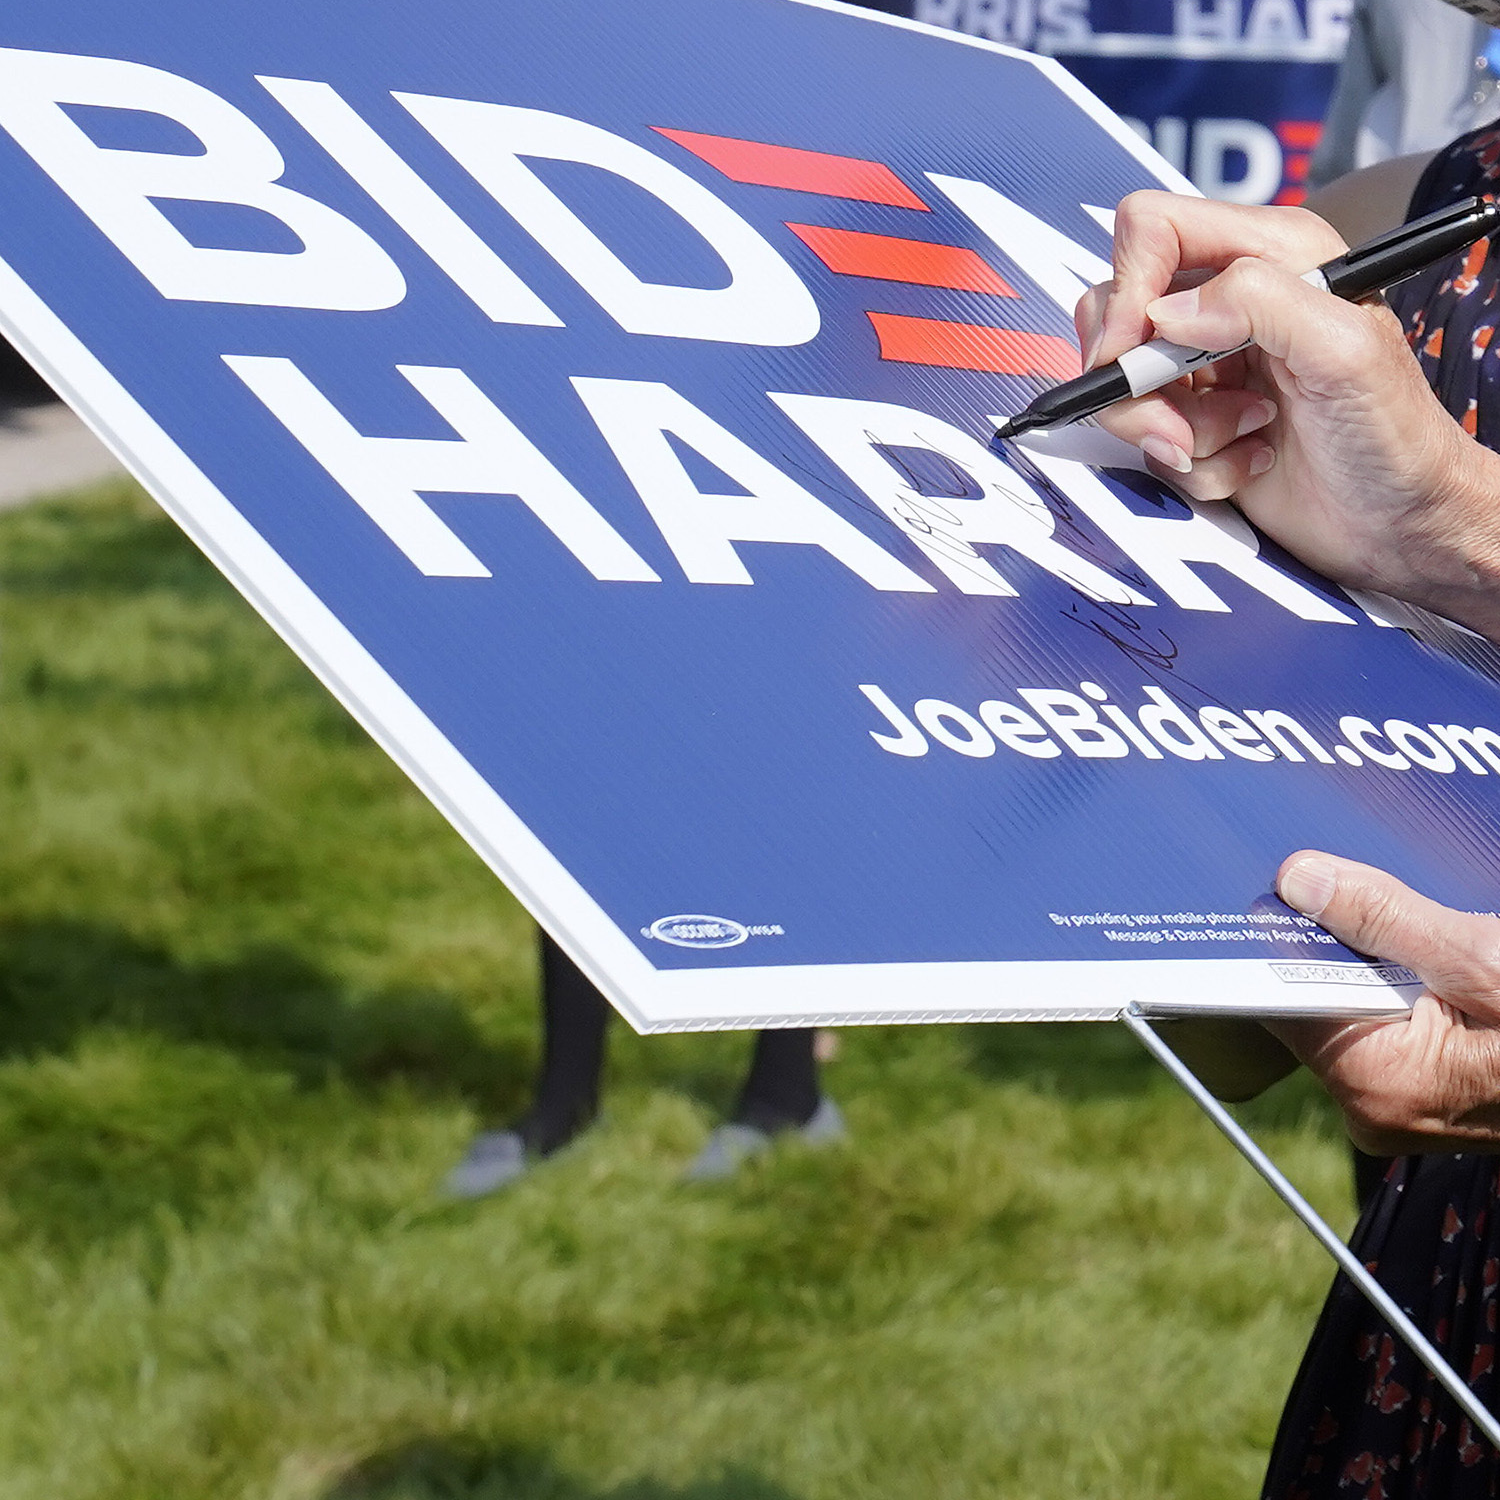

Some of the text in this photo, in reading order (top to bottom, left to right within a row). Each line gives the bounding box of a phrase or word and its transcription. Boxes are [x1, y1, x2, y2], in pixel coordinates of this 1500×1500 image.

[220, 354, 1490, 642] HARR
[1048, 912, 1072, 927] By
[1072, 912, 1134, 927] providing
[1132, 913, 1161, 926] your
[1162, 912, 1206, 925] mobile
[1207, 912, 1246, 926] phone
[1246, 912, 1292, 926] number
[1103, 929, 1165, 945] Message
[1177, 929, 1209, 942] Data
[1208, 929, 1245, 942] Rates
[1244, 930, 1272, 944] May
[1308, 967, 1331, 980] FOR
[1346, 969, 1371, 982] THE
